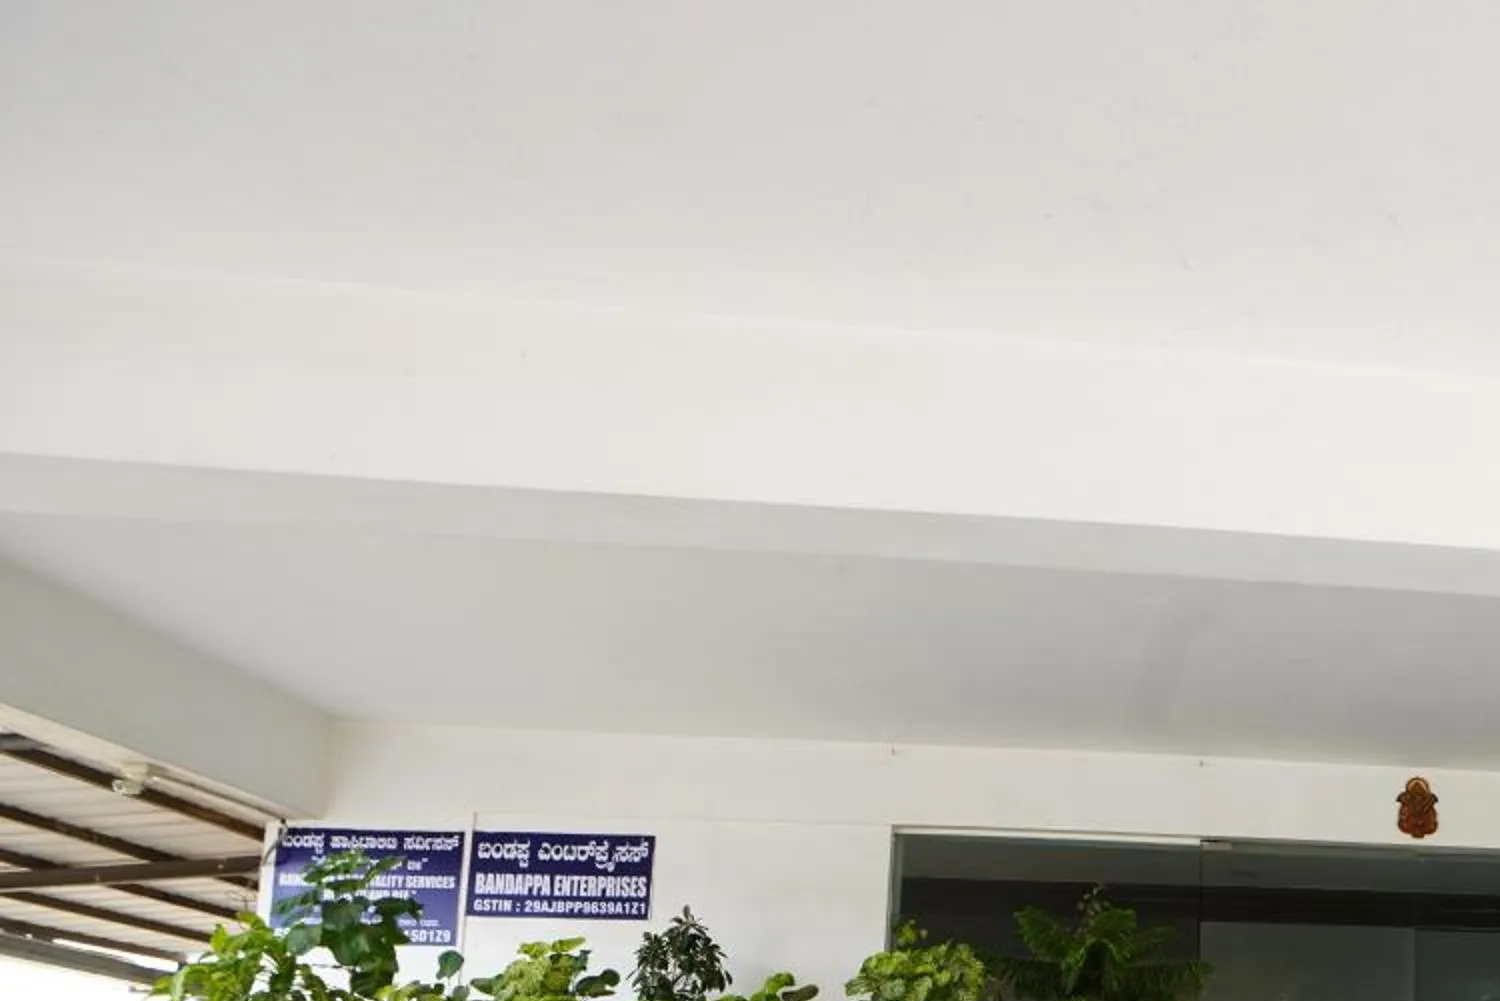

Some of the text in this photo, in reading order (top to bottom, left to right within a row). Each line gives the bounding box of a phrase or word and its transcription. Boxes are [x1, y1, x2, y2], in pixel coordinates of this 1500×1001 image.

[477, 840, 531, 868] ಬಂಡಪ್ಪ
[405, 875, 456, 888] SERVICES
[474, 872, 648, 898] BANDAPPA ENTERPRISES
[473, 898, 512, 912] GSTIN
